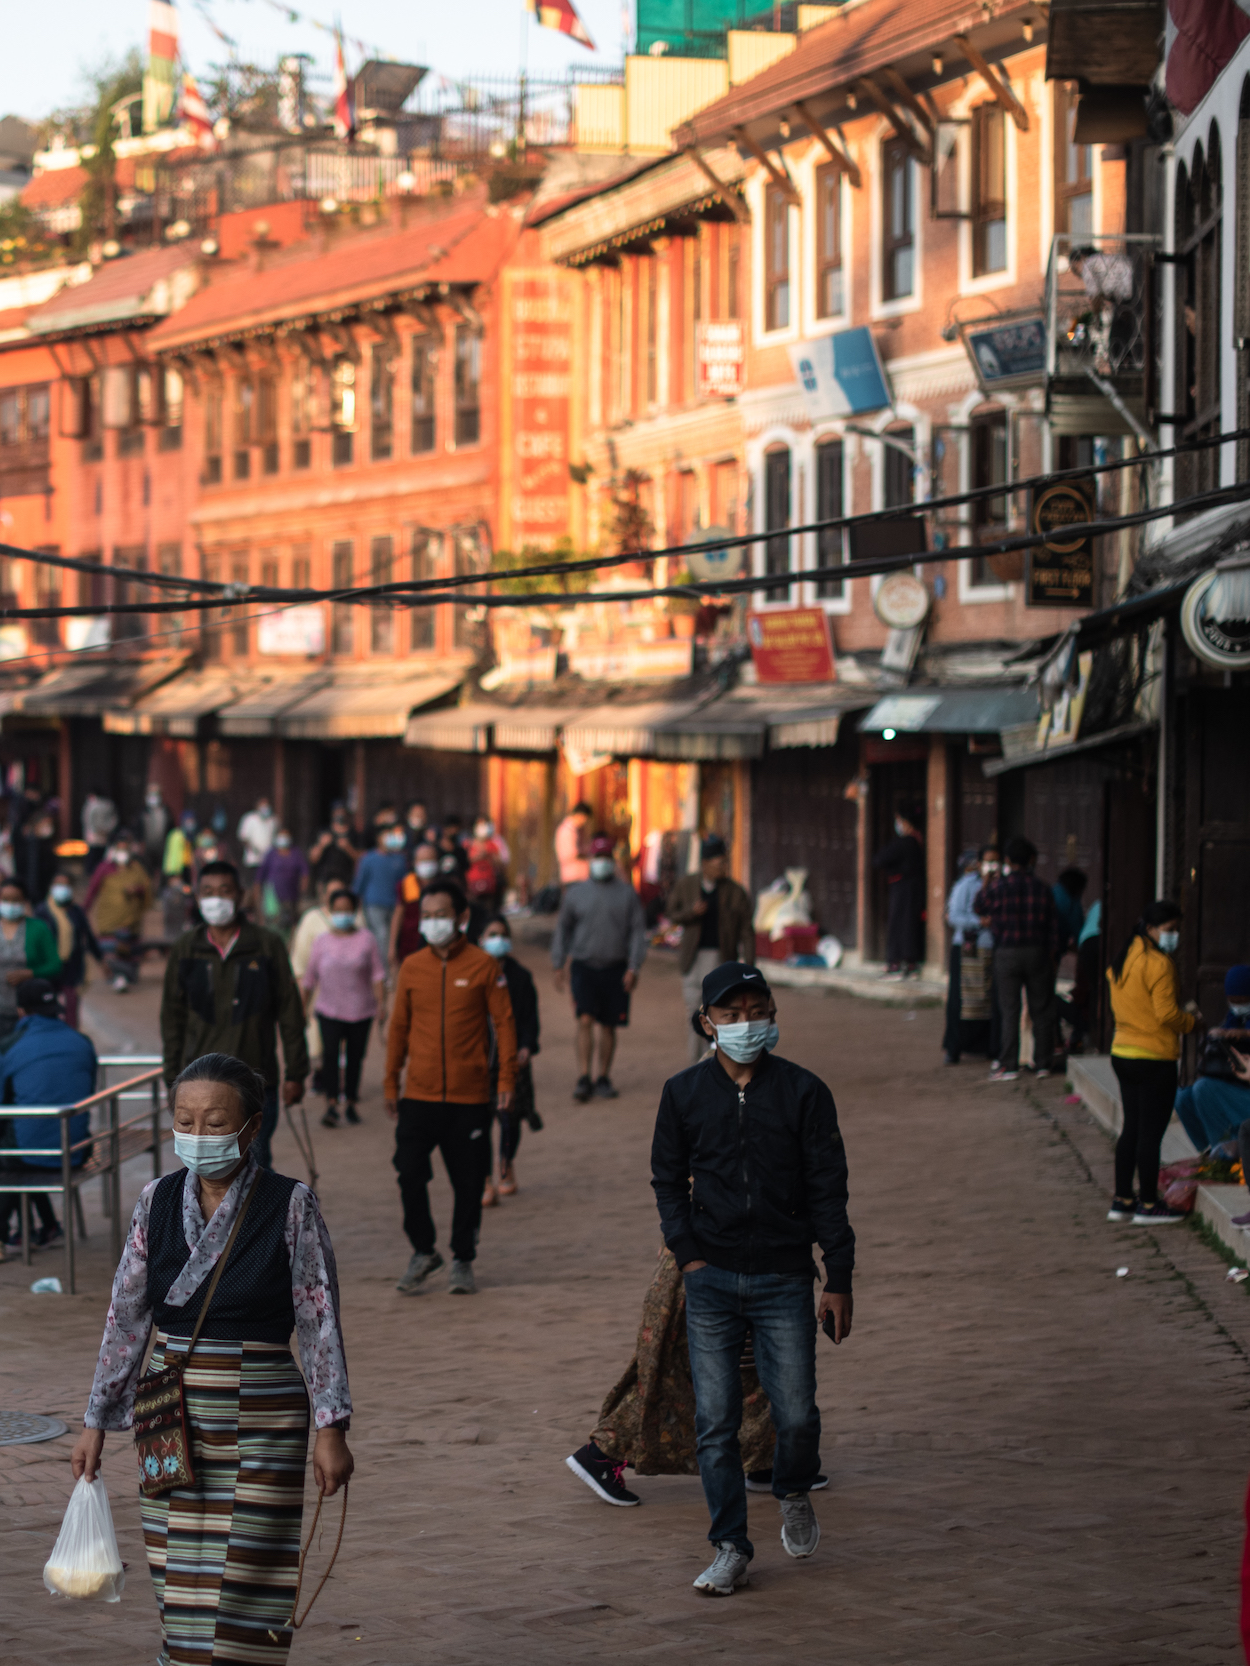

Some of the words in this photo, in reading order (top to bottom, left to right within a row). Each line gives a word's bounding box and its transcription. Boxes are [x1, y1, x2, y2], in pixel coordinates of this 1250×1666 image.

[516, 431, 563, 459] CAFE
[1034, 569, 1061, 586] FIRST
[1062, 569, 1091, 587] FLOOR
